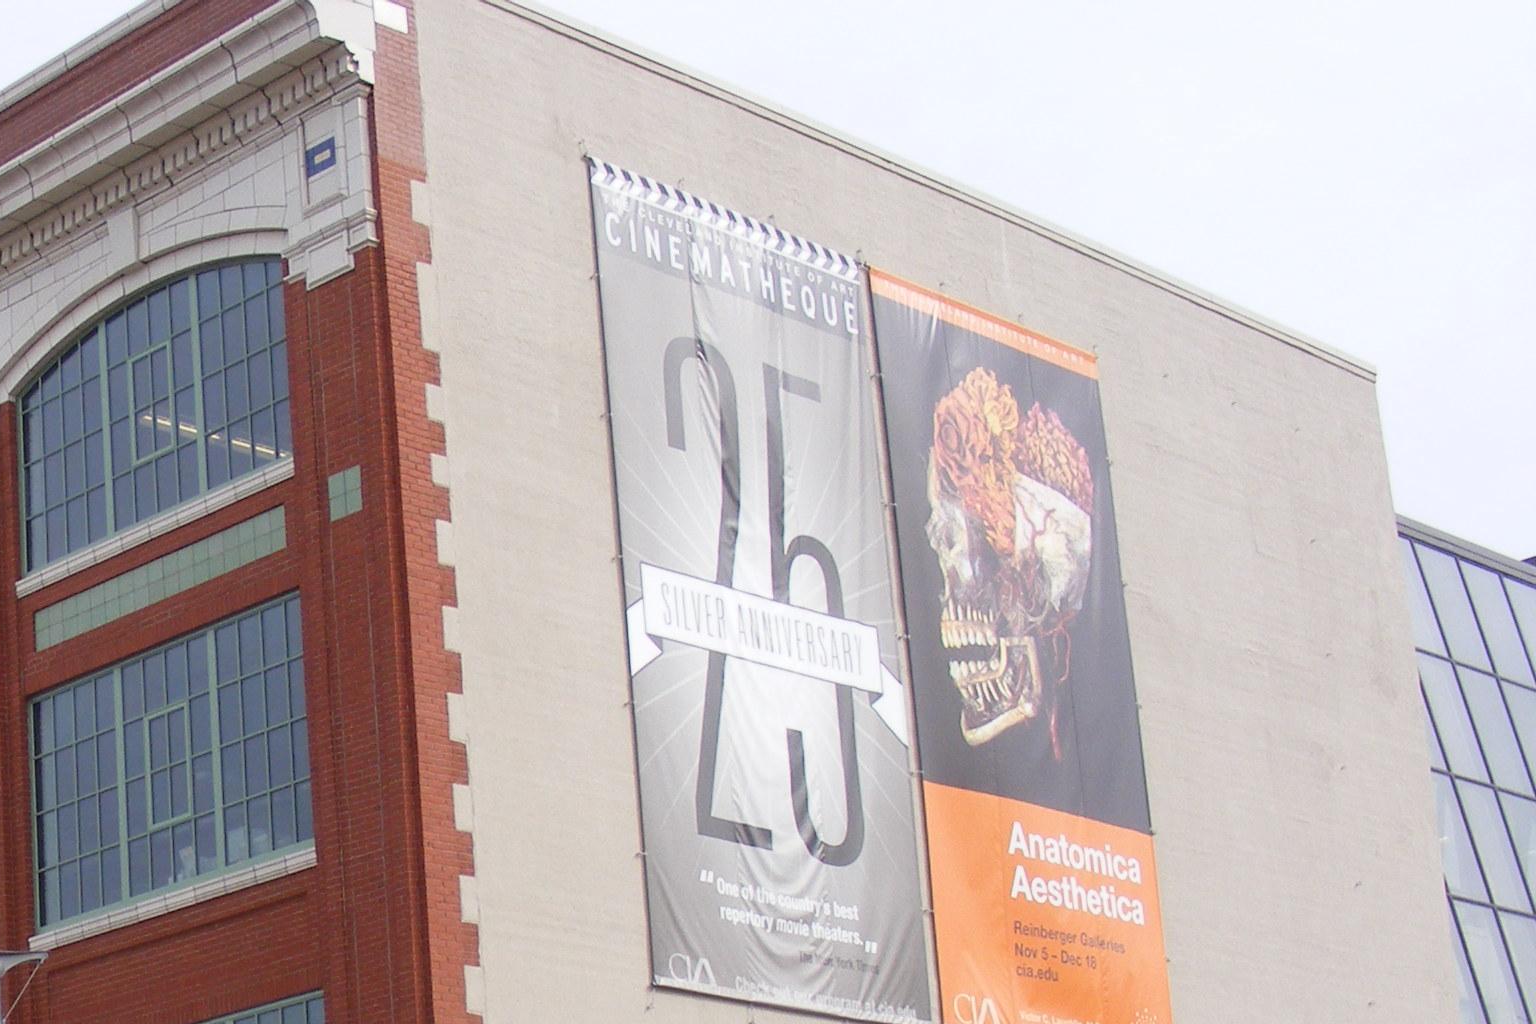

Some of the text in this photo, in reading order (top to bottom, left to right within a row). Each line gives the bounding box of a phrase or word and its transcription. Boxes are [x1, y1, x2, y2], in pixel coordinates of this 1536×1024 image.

[604, 211, 859, 335] CINEMATHEQUE
[807, 270, 823, 285] OF
[830, 280, 855, 298] ART
[660, 582, 863, 677] SILVER ANNIVERSARY
[1007, 821, 1142, 885] Anatomica
[740, 884, 754, 901] of
[833, 900, 859, 921] best
[1010, 865, 1145, 926] Aesthetica
[719, 905, 774, 933] repertory
[775, 918, 809, 937] movie
[1013, 920, 1126, 954] Reinberger Galleries
[1014, 942, 1037, 959] Nov
[1041, 946, 1049, 961] 5
[1060, 950, 1082, 967] Dec
[1015, 965, 1059, 982] cia.edu
